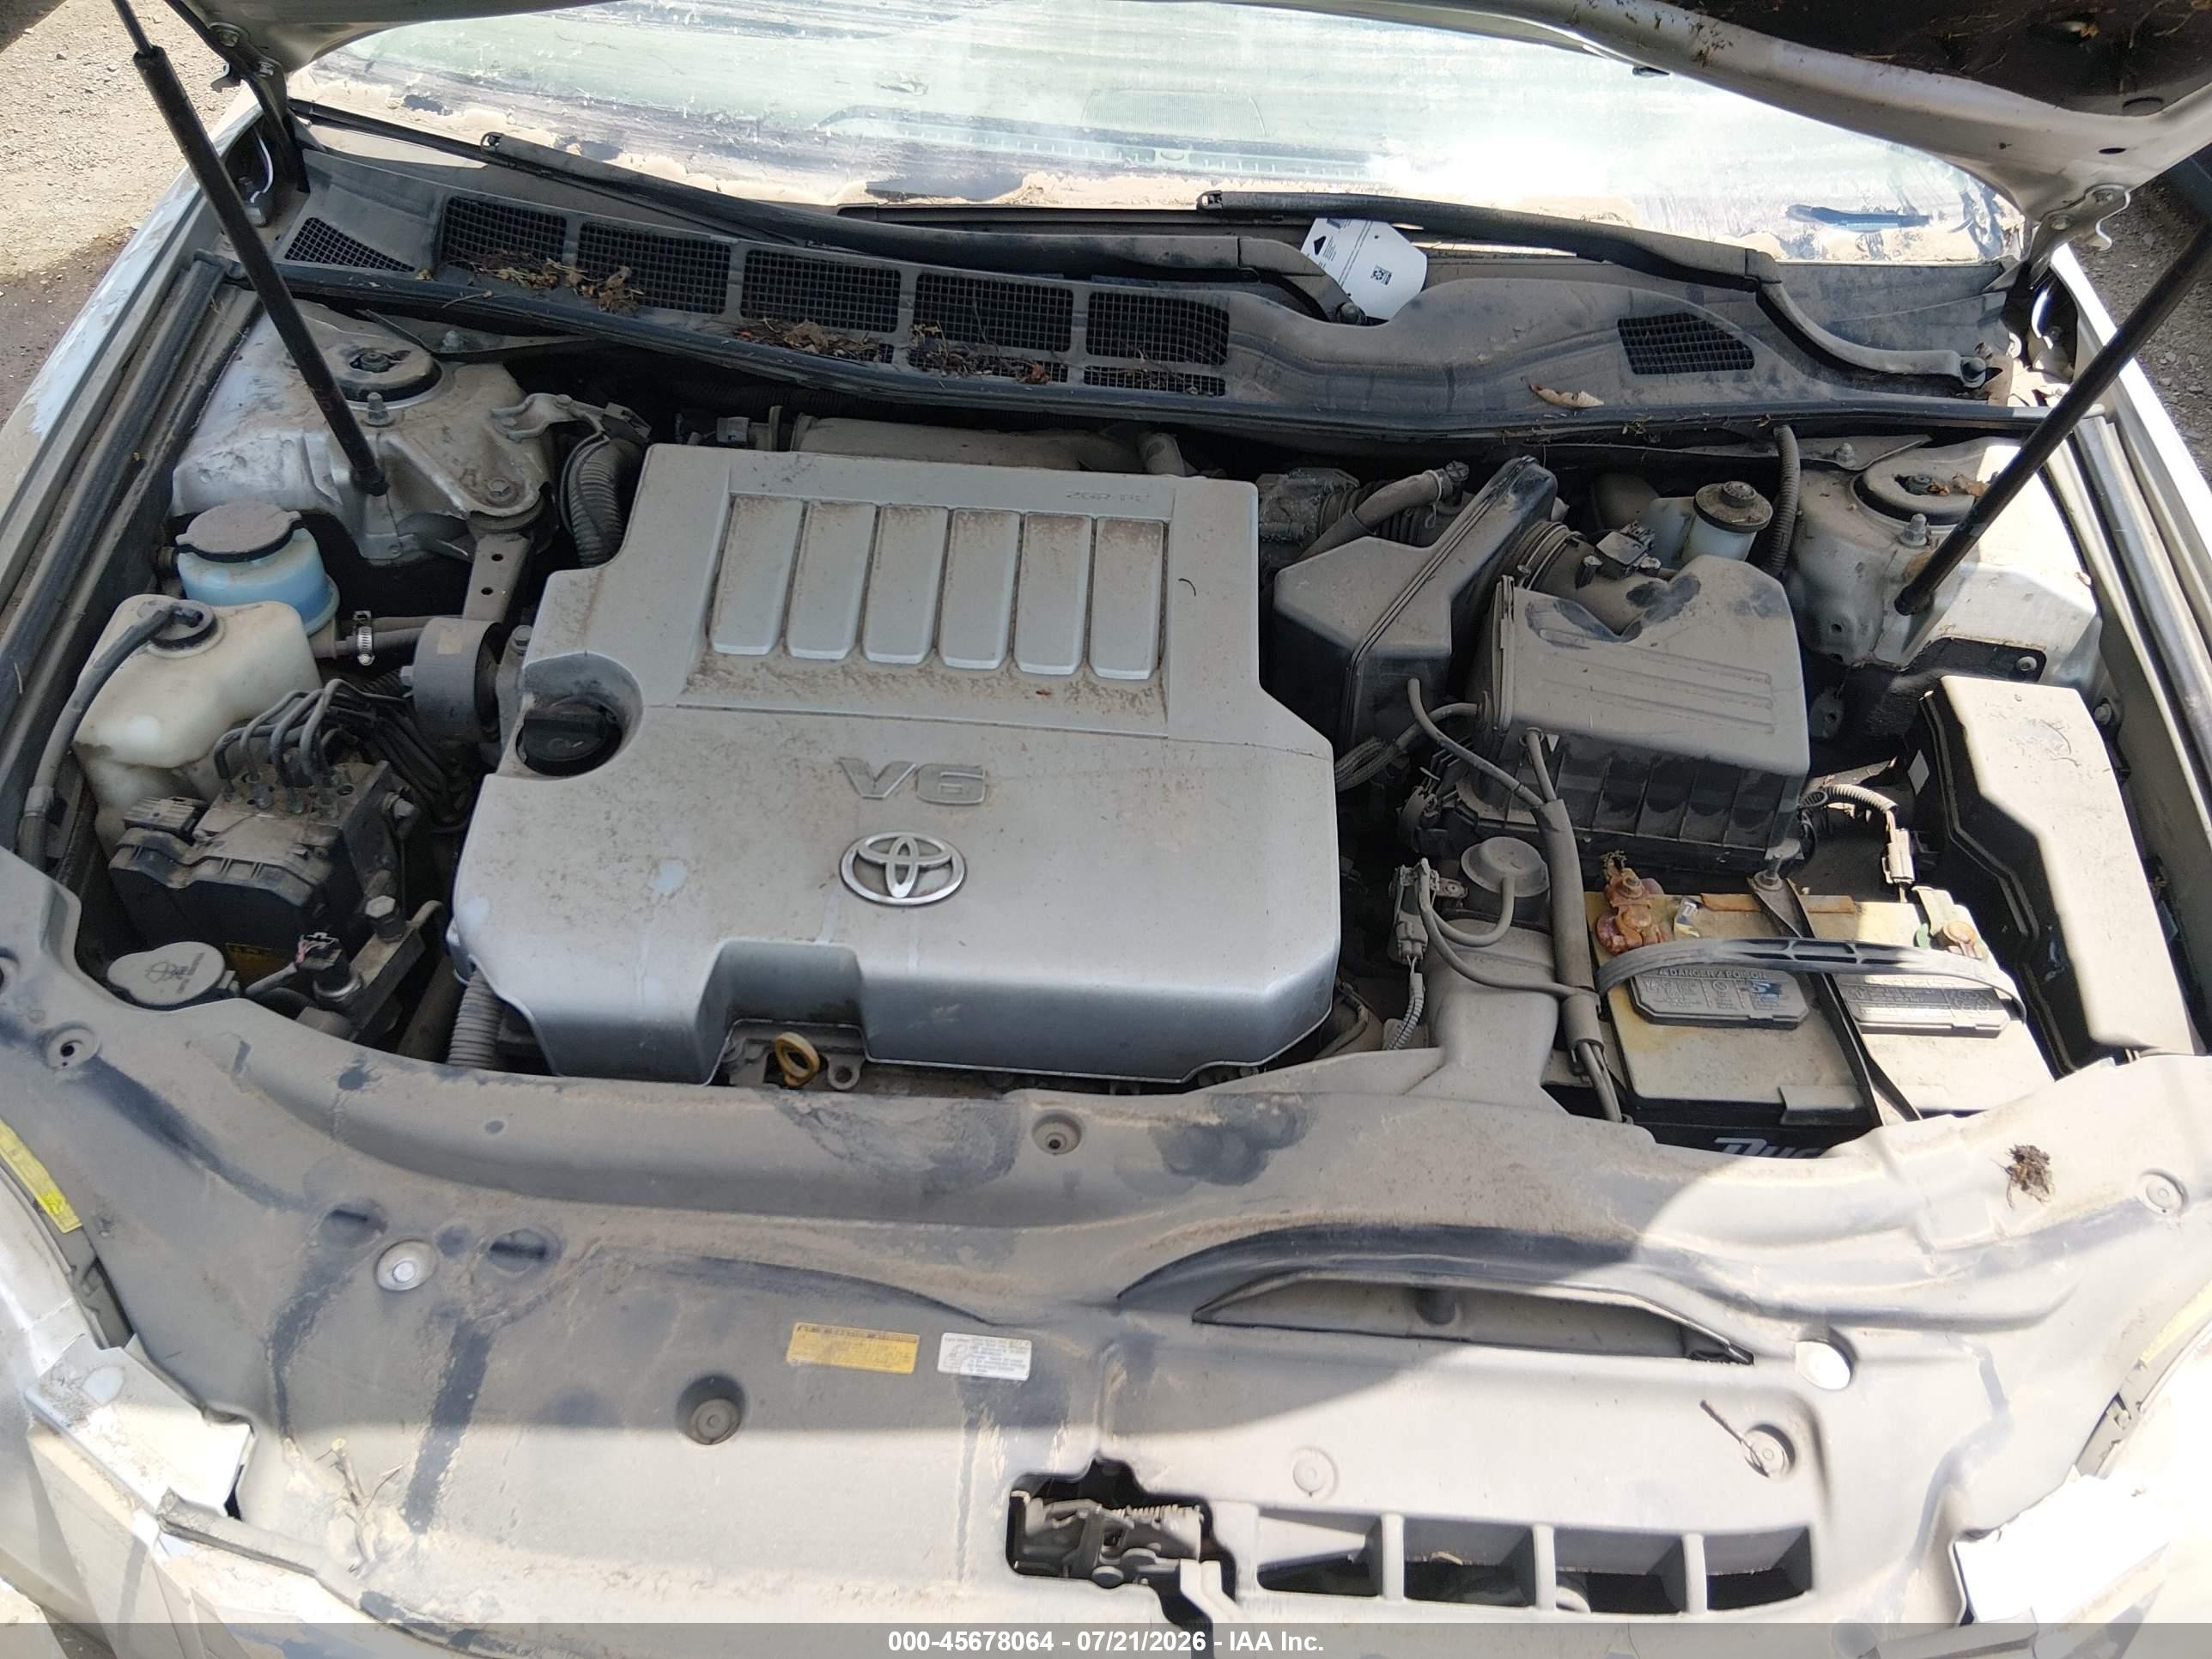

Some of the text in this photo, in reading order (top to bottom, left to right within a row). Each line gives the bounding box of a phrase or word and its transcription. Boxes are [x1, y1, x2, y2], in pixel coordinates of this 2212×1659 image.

[837, 757, 988, 805] V6
[1669, 969, 1767, 981] DANGER POISON
